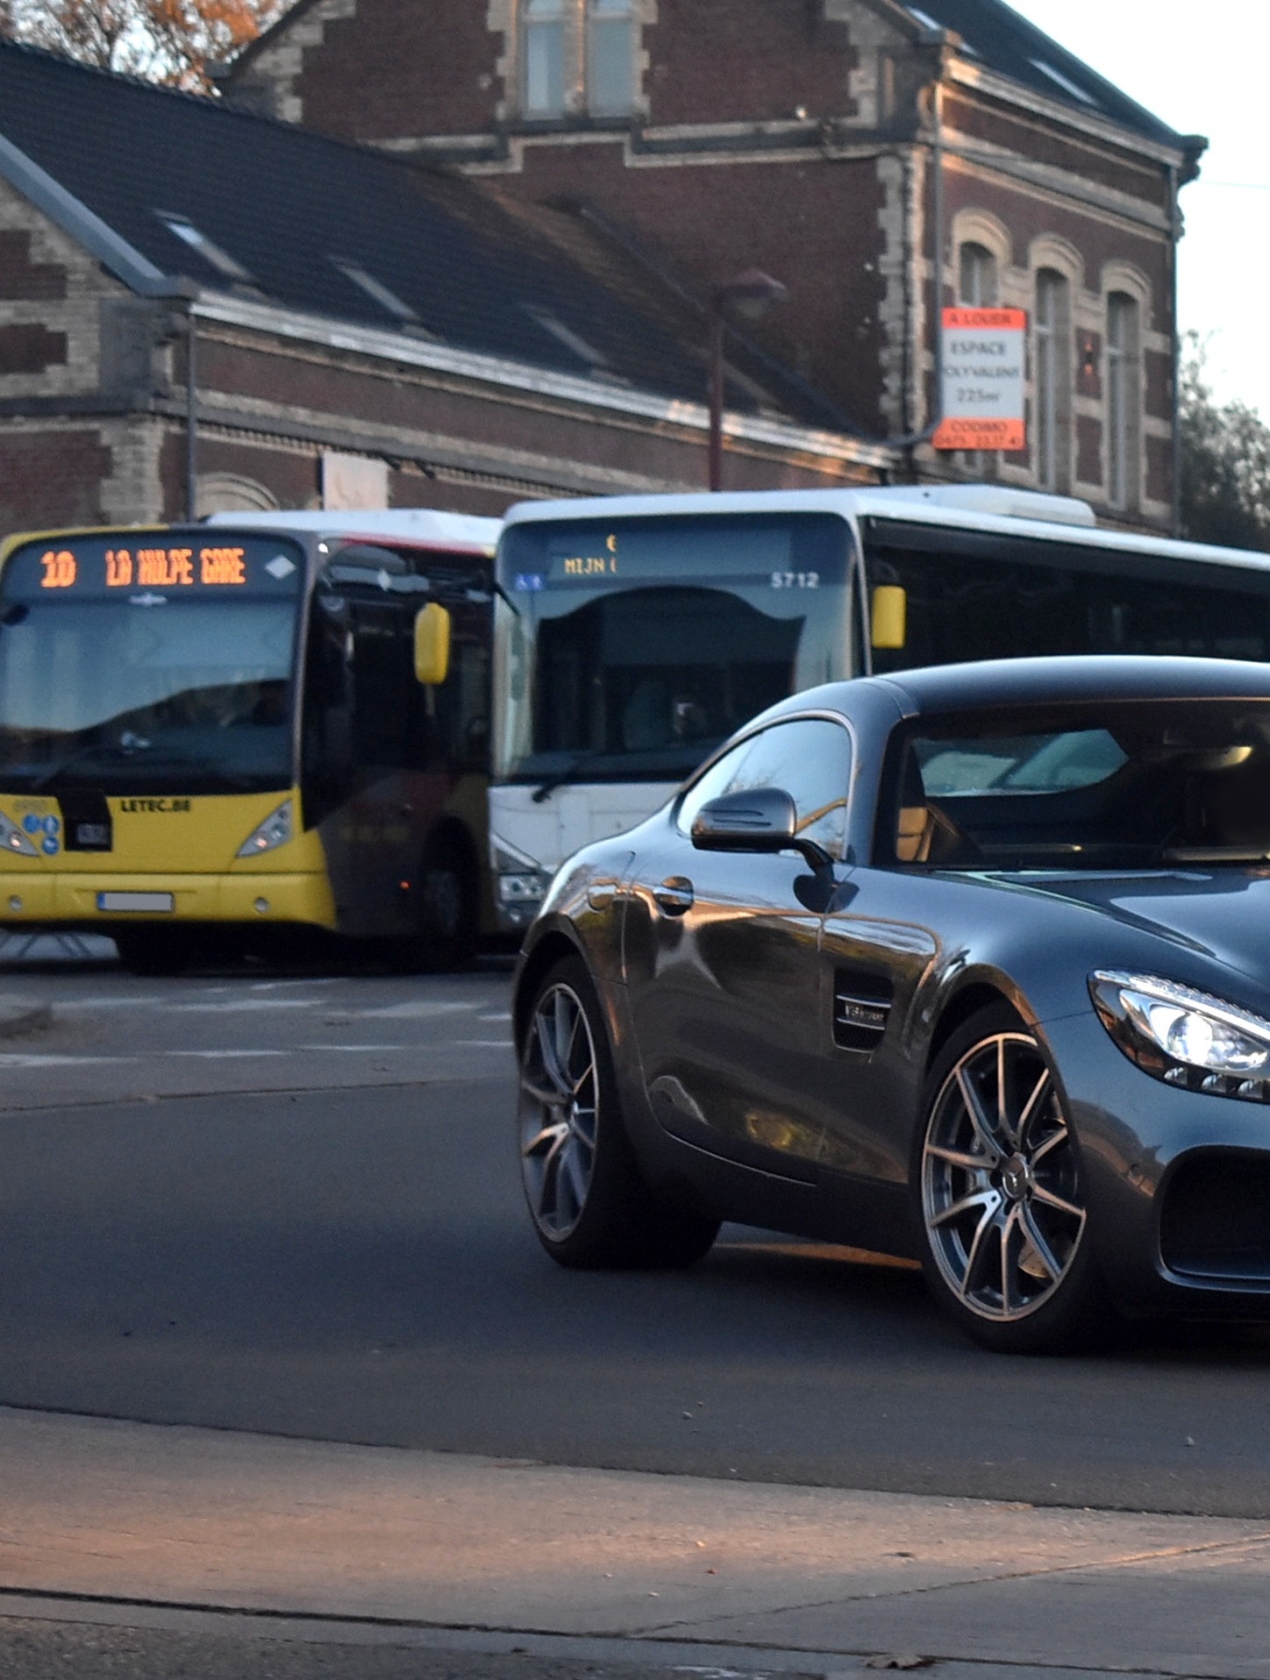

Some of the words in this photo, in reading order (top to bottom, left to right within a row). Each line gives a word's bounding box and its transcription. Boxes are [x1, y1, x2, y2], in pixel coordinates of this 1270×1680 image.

[950, 341, 1006, 355] ESPACE
[943, 366, 1020, 378] OLYVALENT
[40, 550, 76, 588] 10
[105, 550, 132, 586] LA
[564, 557, 605, 574] MIJN
[770, 571, 820, 589] 5712
